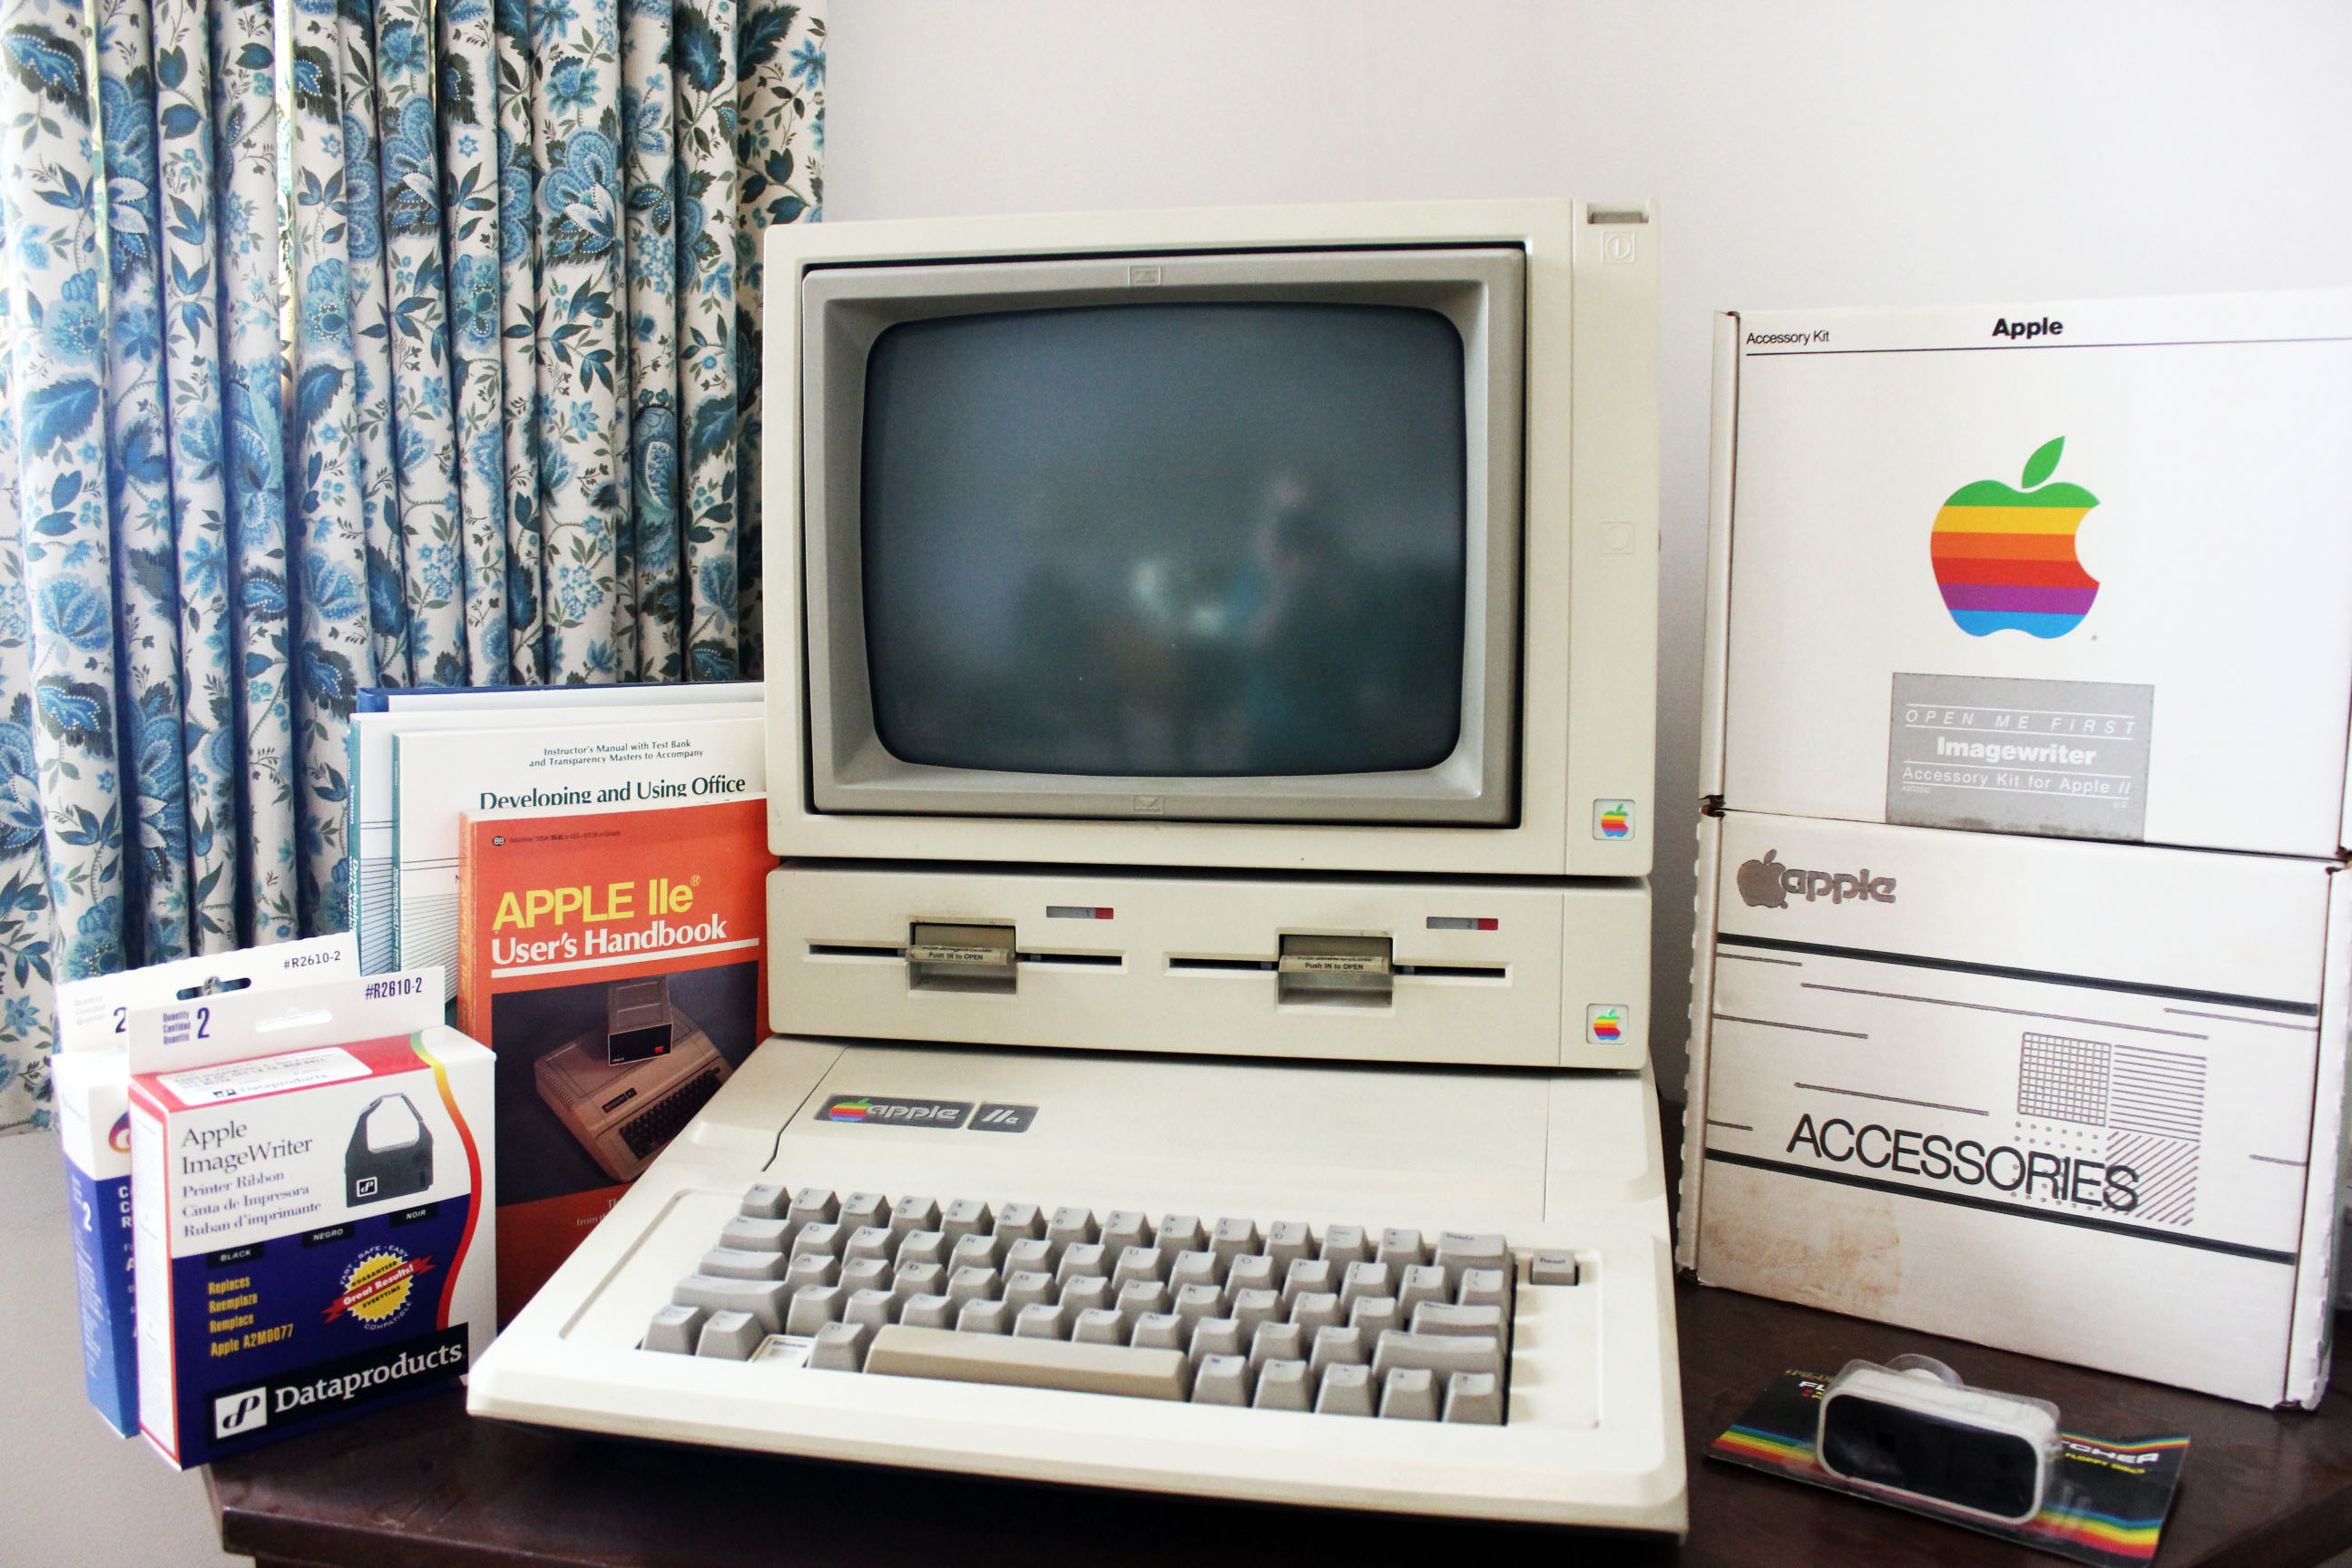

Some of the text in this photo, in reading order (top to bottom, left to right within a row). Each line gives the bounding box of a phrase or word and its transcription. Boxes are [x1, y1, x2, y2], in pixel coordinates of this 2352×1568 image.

[1746, 329, 1830, 346] Accessory Kit
[1992, 317, 2064, 339] Apple
[1905, 709, 2136, 736] OPEN ME FIRST
[528, 748, 704, 768] and Transparency Masters to Accompany
[544, 738, 691, 756] Instructor's Manual with Test Bank
[1936, 735, 2097, 766] Imagewriter
[479, 774, 747, 810] Developing and Using Office
[1902, 766, 1988, 789] Accessory
[1996, 772, 2020, 788] Kit
[2027, 774, 2051, 789] for
[2059, 777, 2111, 795] Apple
[1780, 867, 1897, 906] apple
[492, 881, 635, 930] APPLE
[491, 914, 728, 965] User's Handbook
[283, 950, 341, 970] #R2610-2
[1305, 962, 1322, 970] Push
[1343, 963, 1364, 971] OPEN
[365, 976, 423, 1001] #R2610-2
[113, 1006, 128, 1034] 2
[196, 1006, 211, 1040] 2
[866, 1104, 961, 1121] apple
[181, 1120, 248, 1151] Apple
[181, 1138, 313, 1175] ImageWriter
[1786, 1112, 2140, 1212] ACCESSORIES
[181, 1171, 285, 1199] Printer Ribbon
[182, 1185, 309, 1219] Cinta de Impresora
[405, 1209, 427, 1220] NOIR
[183, 1201, 322, 1238] Ruban d'imprimante
[312, 1228, 344, 1242] NEGRO
[220, 1249, 252, 1263] BLACK
[208, 1276, 251, 1296] Replaces
[339, 1263, 354, 1286] FAST
[343, 1263, 416, 1306] Great Results!
[351, 1260, 398, 1288] GUARANTEED
[209, 1292, 259, 1314] Reemplaze
[362, 1285, 401, 1308] EVERYTIME
[209, 1314, 255, 1334] Remplace
[363, 1300, 413, 1330] COMPATIBLE
[210, 1323, 295, 1357] Apple A2M0077
[274, 1343, 464, 1413] Dataproducts
